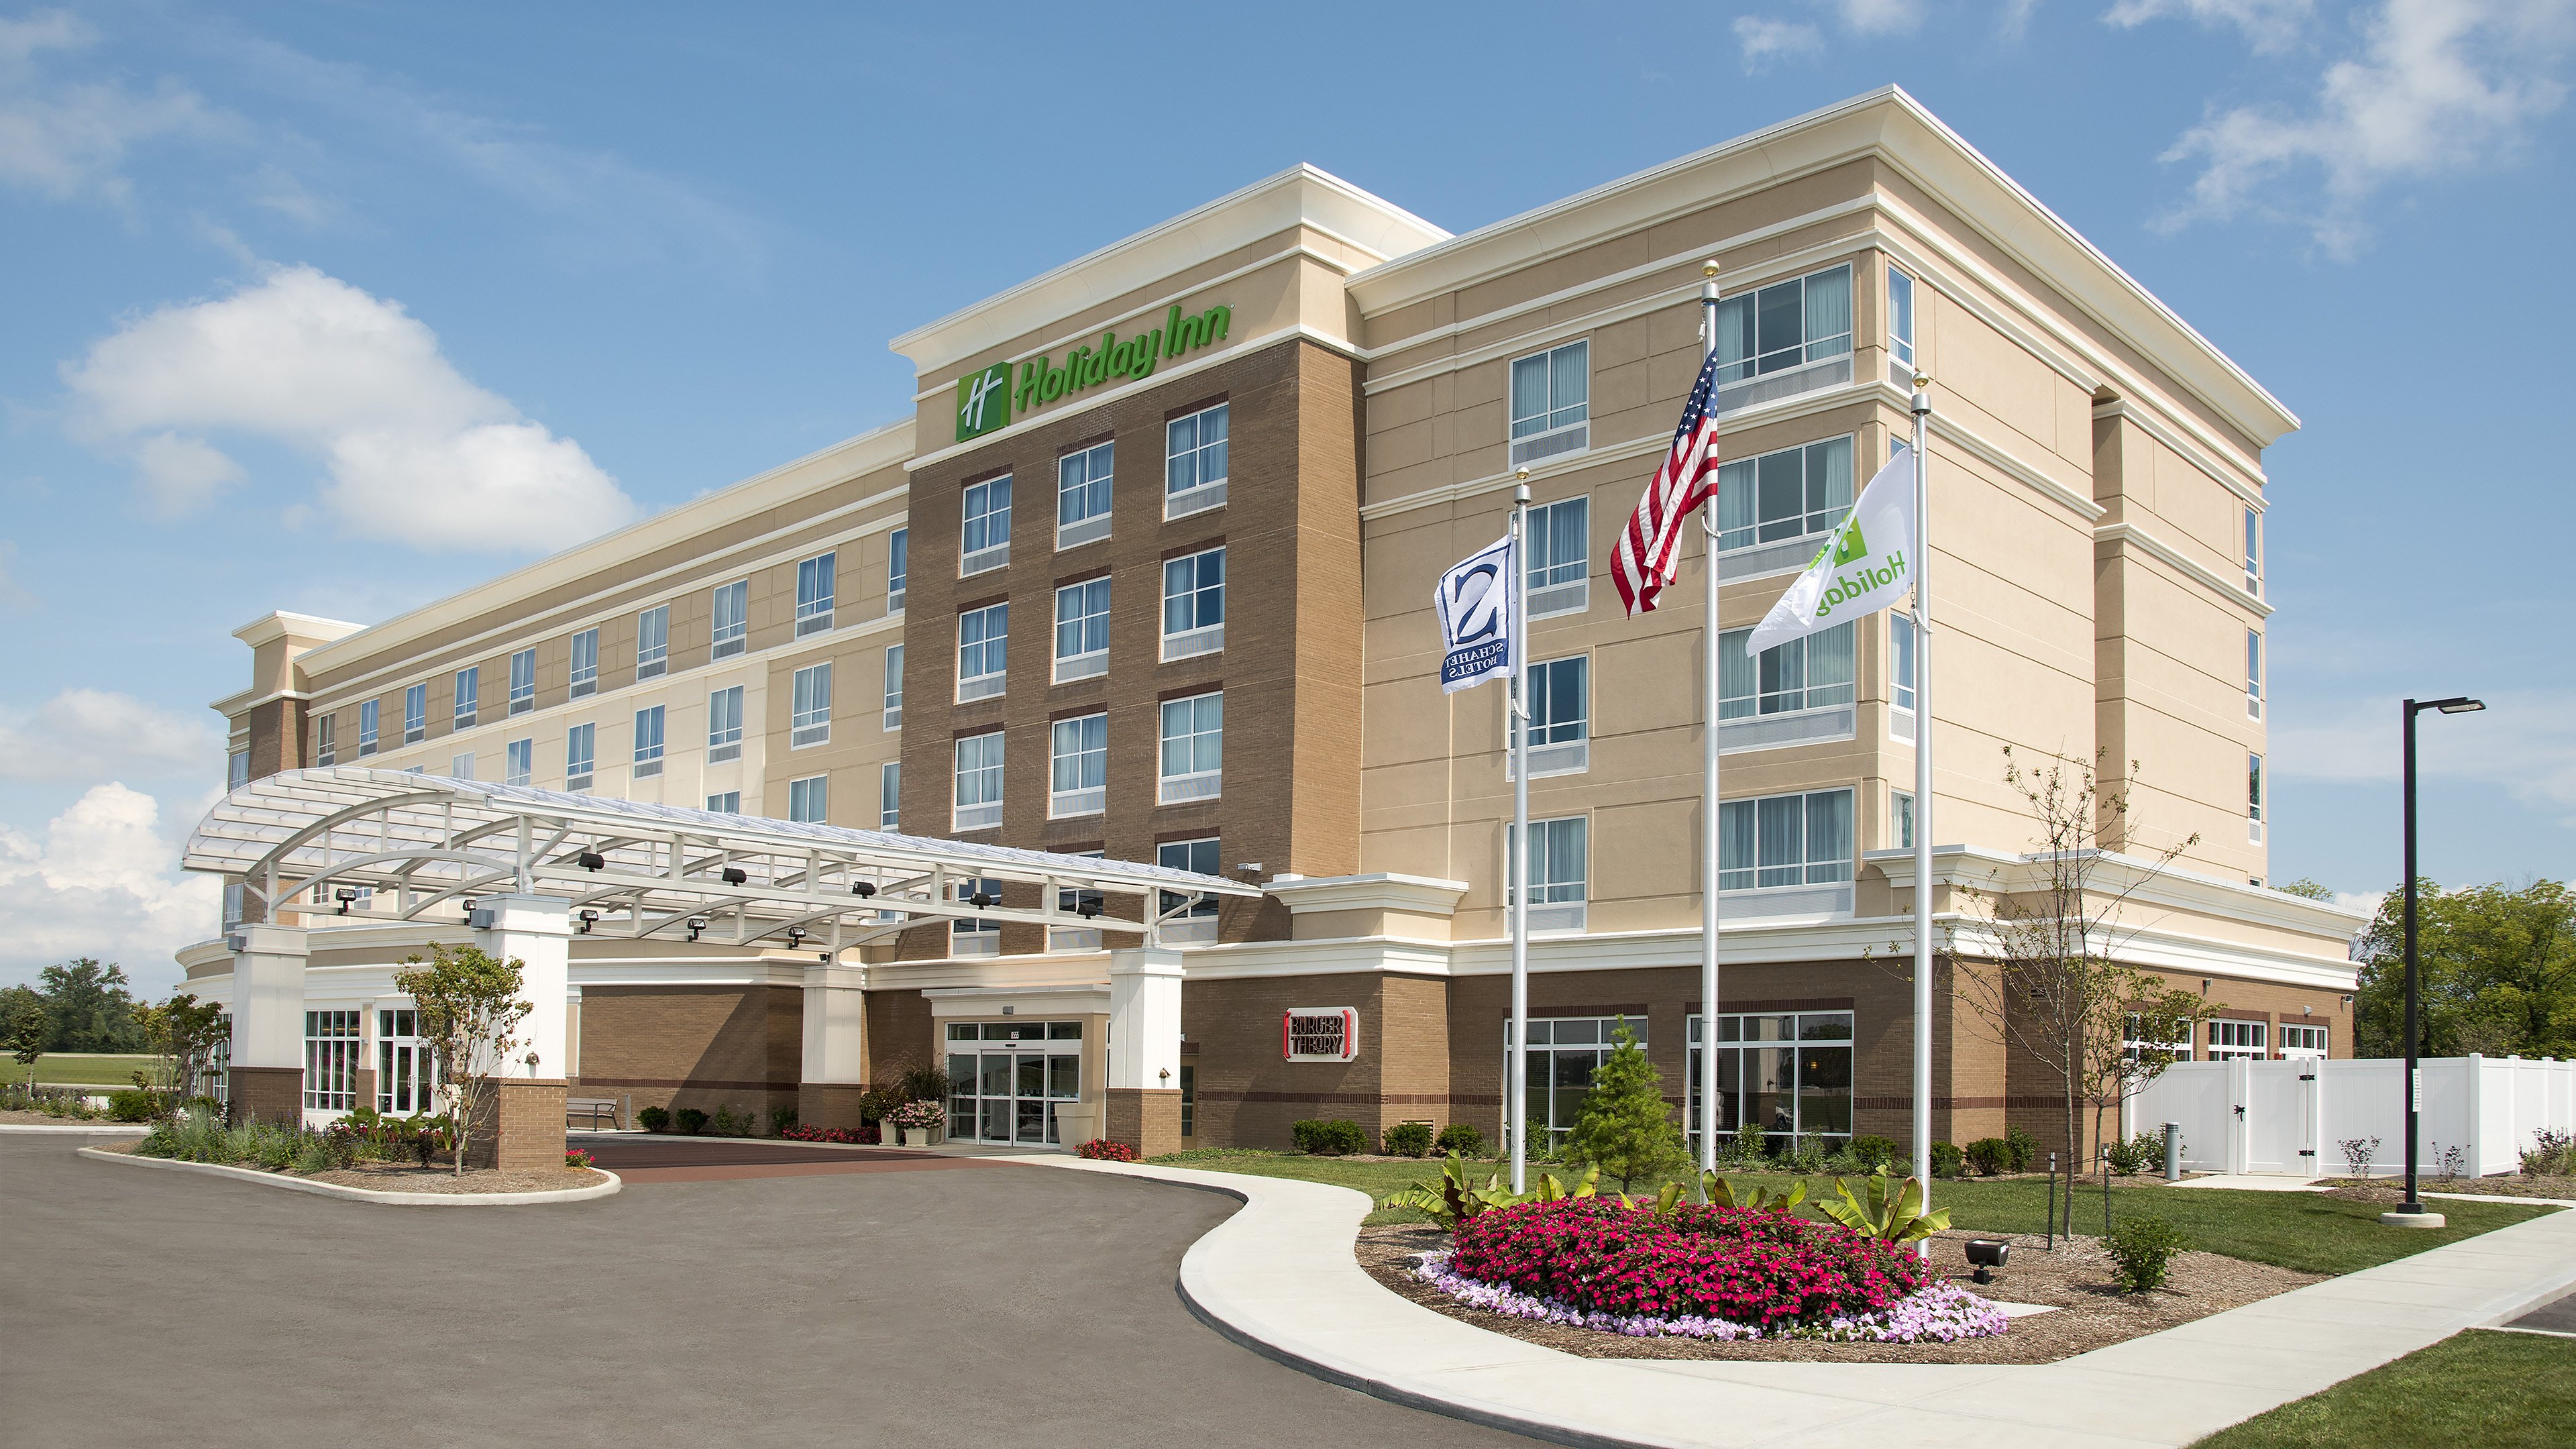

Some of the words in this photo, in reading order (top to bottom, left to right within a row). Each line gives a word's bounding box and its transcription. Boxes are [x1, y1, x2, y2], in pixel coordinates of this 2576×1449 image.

[1014, 329, 1162, 412] Holiday
[1162, 305, 1231, 359] Inn
[1291, 1016, 1344, 1034] BURGER
[1291, 1036, 1343, 1054] THEORY
